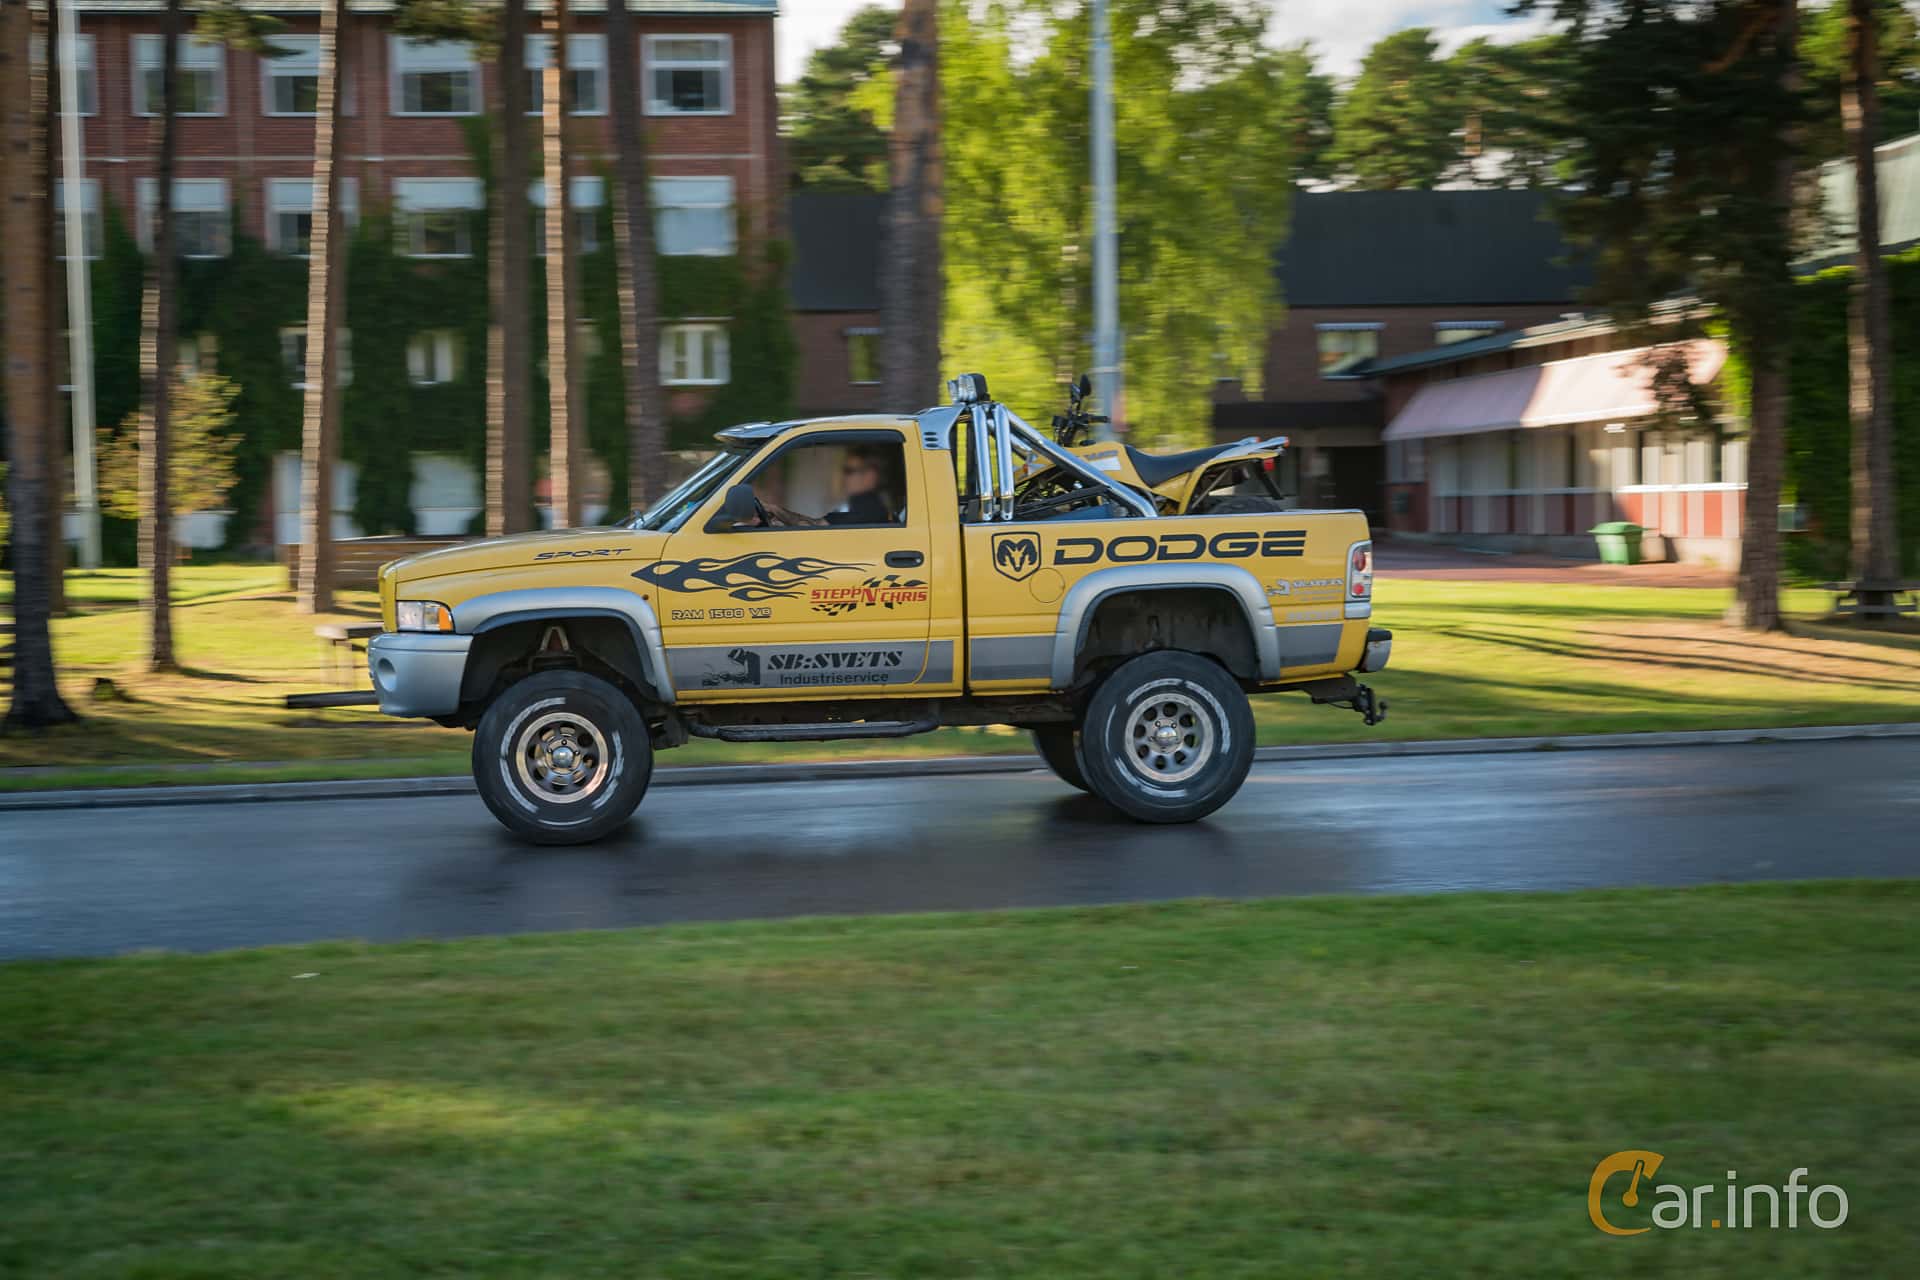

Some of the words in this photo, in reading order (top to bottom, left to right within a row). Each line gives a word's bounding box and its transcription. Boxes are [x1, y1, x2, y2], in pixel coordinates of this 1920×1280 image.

[533, 548, 632, 560] SPORT
[1053, 530, 1307, 566] DODGE
[671, 609, 705, 620] RAM
[709, 608, 745, 619] 1500
[780, 671, 889, 685] Industriservice
